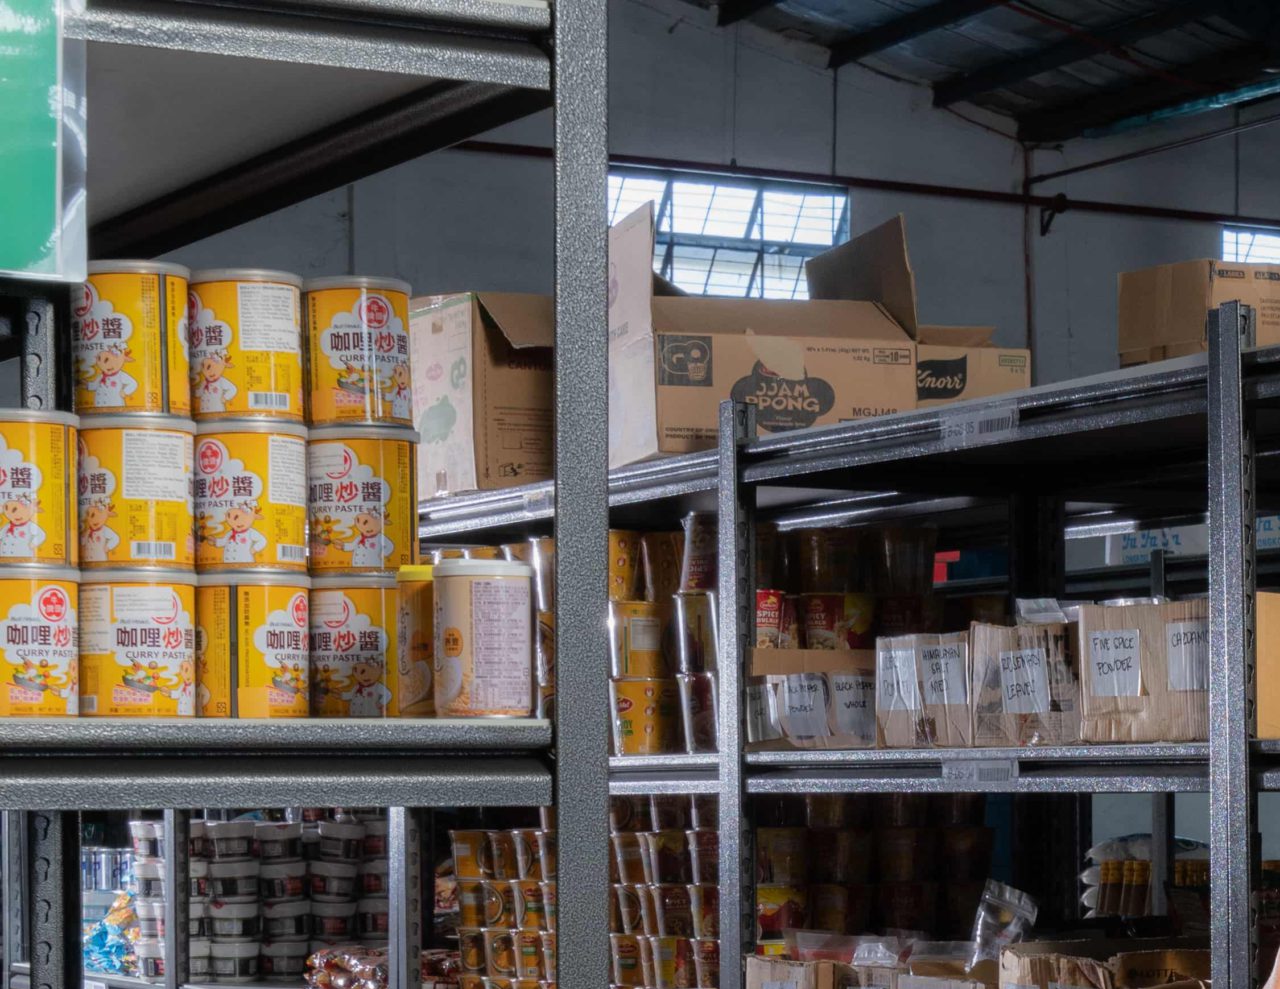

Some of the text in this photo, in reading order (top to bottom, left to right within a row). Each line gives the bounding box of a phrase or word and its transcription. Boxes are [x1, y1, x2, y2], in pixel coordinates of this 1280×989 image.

[339, 354, 400, 364] CURRY PASTE
[917, 370, 964, 390] Knorr
[756, 383, 811, 398] JJAM
[208, 499, 235, 508] PASTE
[335, 504, 364, 514] PASTE
[1092, 637, 1135, 651] FIVE SPICE
[1171, 631, 1209, 648] CARDAMO
[16, 648, 74, 658] CURRY PASTE
[125, 650, 187, 660] CURRY PASTE
[274, 653, 300, 662] CURRY
[332, 653, 361, 662] PASTE
[1096, 656, 1133, 676] POWDER
